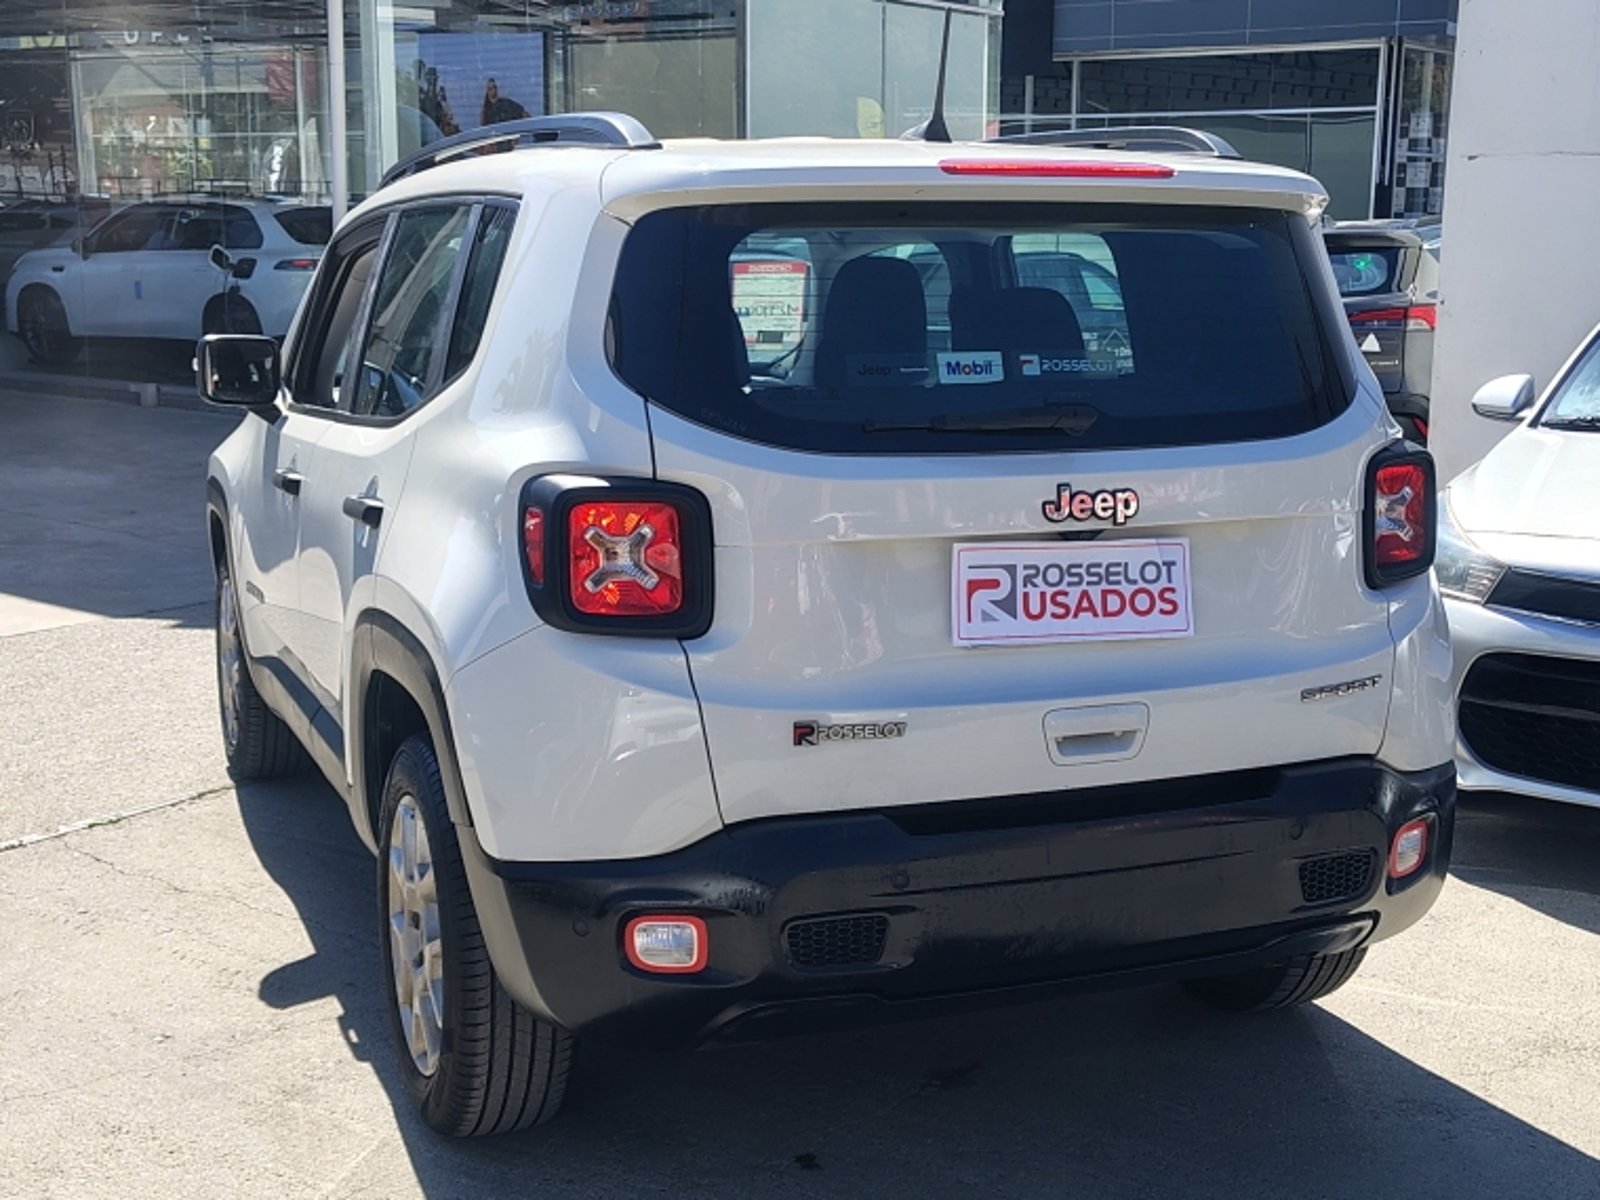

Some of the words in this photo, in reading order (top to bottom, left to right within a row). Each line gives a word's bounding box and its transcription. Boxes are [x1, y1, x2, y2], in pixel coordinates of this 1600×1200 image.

[945, 360, 993, 376] Mobil
[1041, 358, 1114, 372] ROSSELOT
[1041, 483, 1139, 526] Jeep
[1022, 560, 1178, 589] ROSSELOT
[1022, 587, 1180, 622] USADOS
[1300, 674, 1383, 702] SPORT
[819, 722, 908, 742] ROSSELOT
